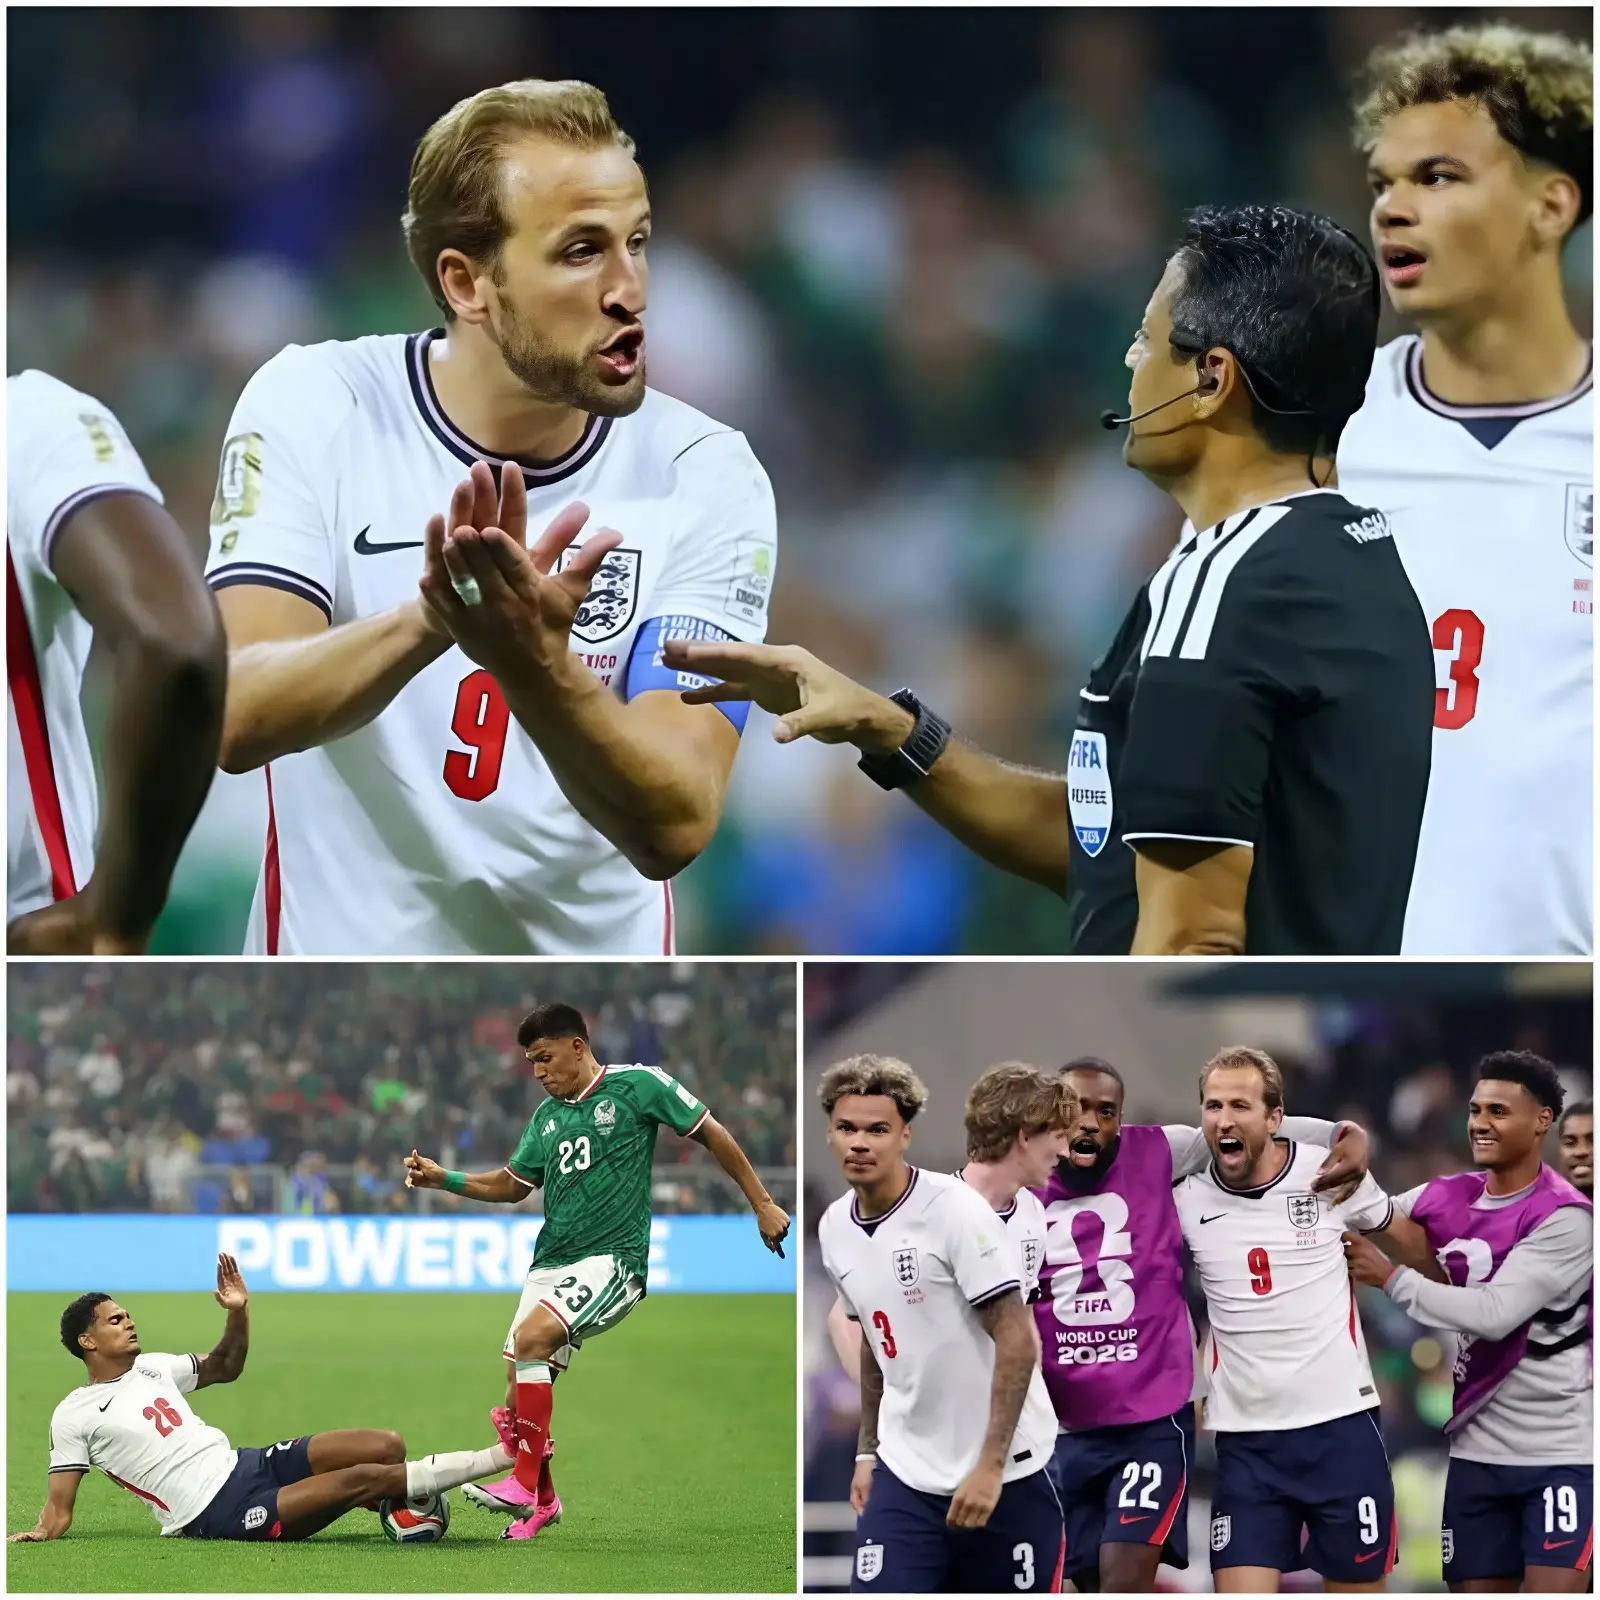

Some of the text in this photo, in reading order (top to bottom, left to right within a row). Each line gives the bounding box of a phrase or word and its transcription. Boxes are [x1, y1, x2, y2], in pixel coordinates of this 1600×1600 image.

[1433, 608, 1485, 730] 3
[443, 668, 511, 802] 9
[558, 1136, 591, 1175] 23
[217, 1218, 669, 1288] POWERE
[1247, 1247, 1272, 1296] 9
[554, 1276, 593, 1313] 23
[1074, 1298, 1113, 1314] FIFA
[872, 1310, 897, 1359] 3
[1055, 1328, 1138, 1344] WORLD CUP
[1057, 1342, 1138, 1365] 2026
[142, 1397, 183, 1438] 26
[1118, 1461, 1163, 1510] 22
[1543, 1485, 1578, 1533] 19
[1358, 1495, 1379, 1545] 9
[1012, 1542, 1036, 1590] 3
